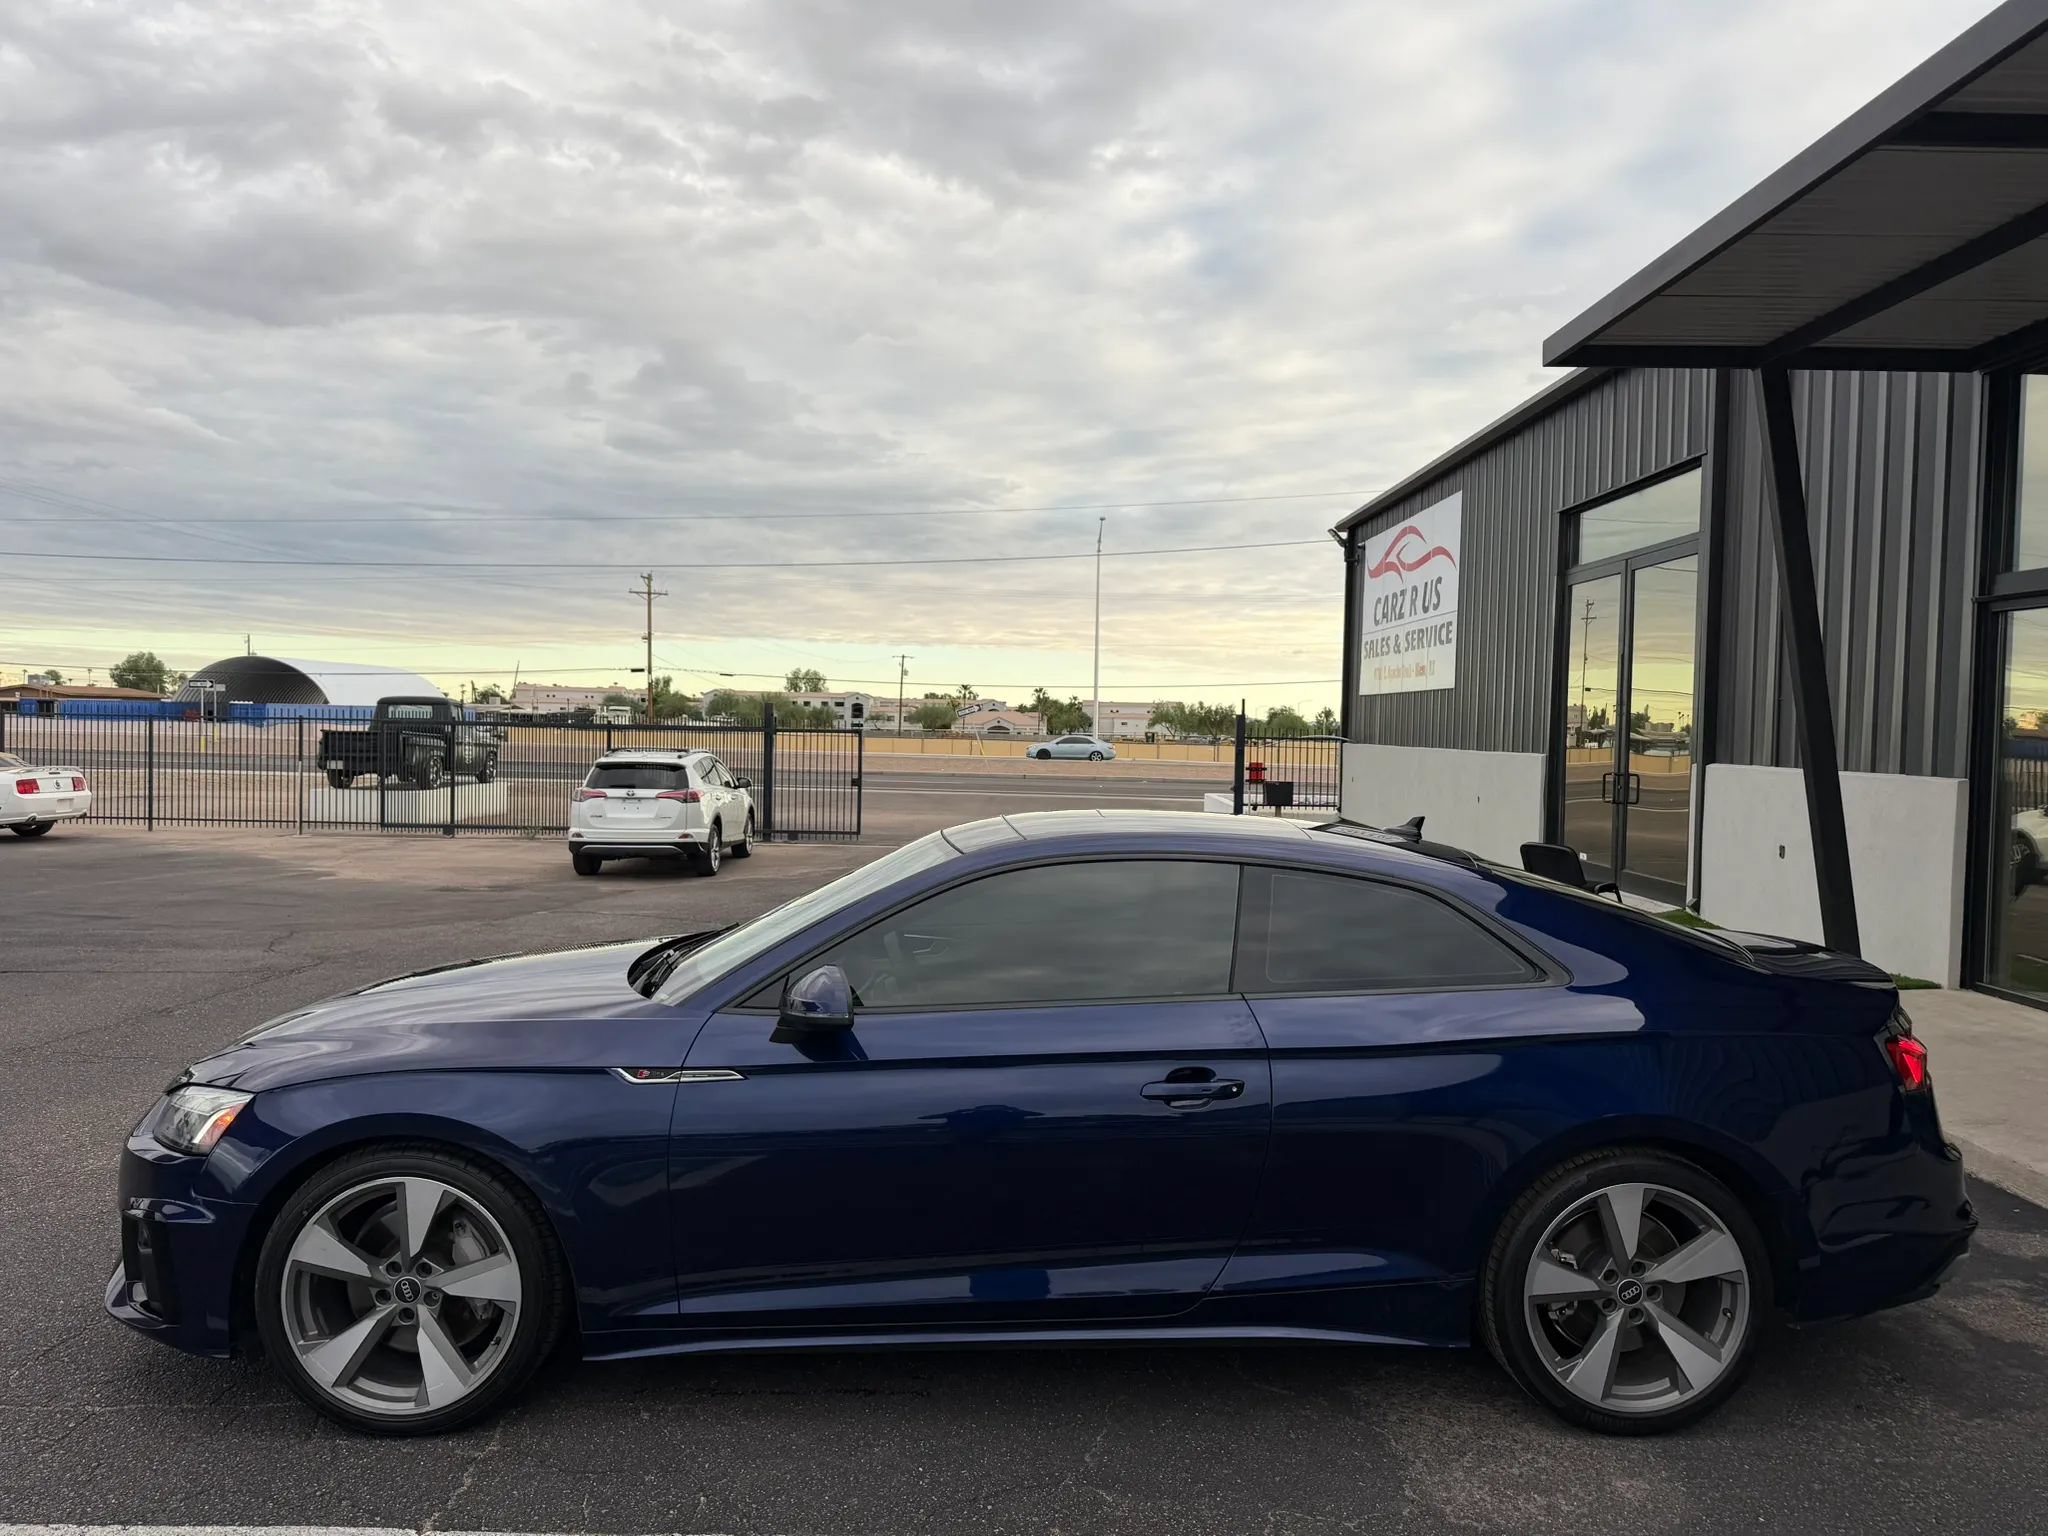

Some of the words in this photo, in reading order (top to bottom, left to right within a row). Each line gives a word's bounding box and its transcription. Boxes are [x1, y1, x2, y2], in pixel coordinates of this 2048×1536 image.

[1373, 588, 1407, 627] CARZ
[1409, 585, 1418, 617] R
[1422, 576, 1442, 614] US
[1363, 636, 1391, 659] SALES
[1393, 633, 1401, 655] &
[1405, 621, 1453, 653] SERVICE
